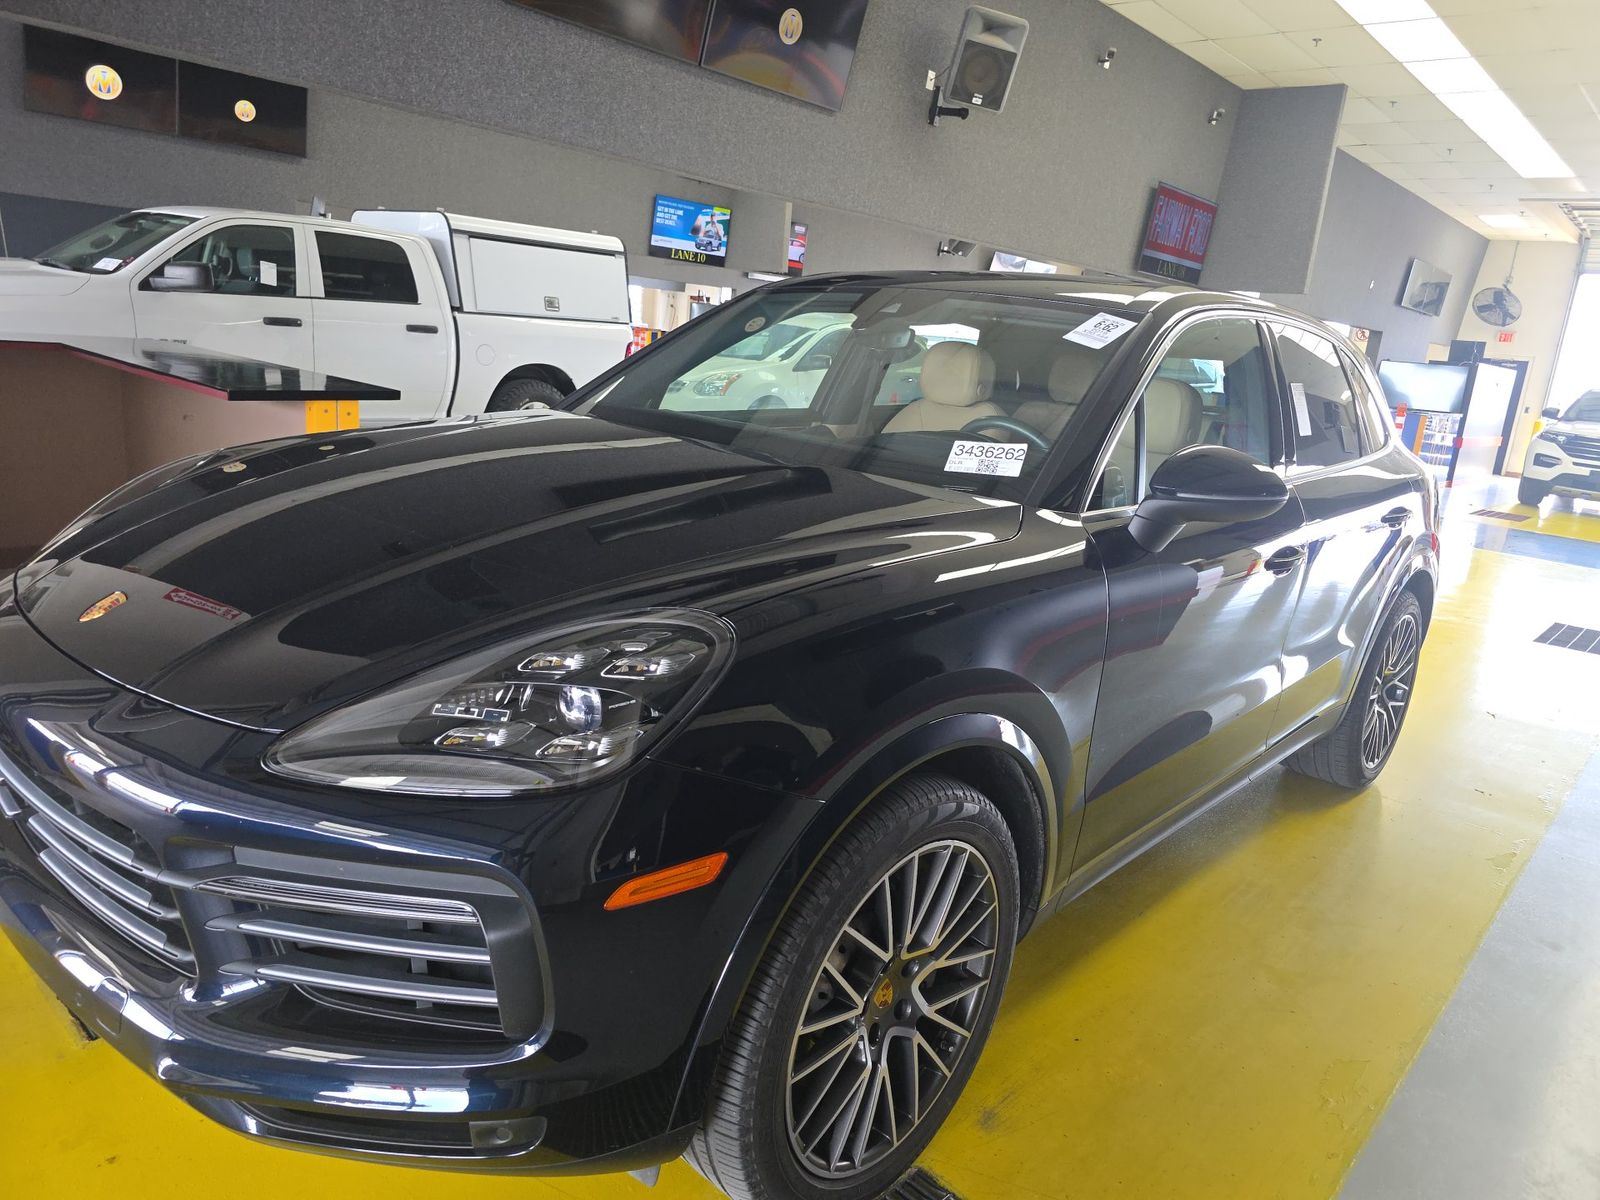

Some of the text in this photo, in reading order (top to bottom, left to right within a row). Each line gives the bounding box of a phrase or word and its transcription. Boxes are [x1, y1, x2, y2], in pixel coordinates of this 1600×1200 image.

[671, 248, 706, 263] LANE 10
[954, 444, 1026, 461] 3436262
